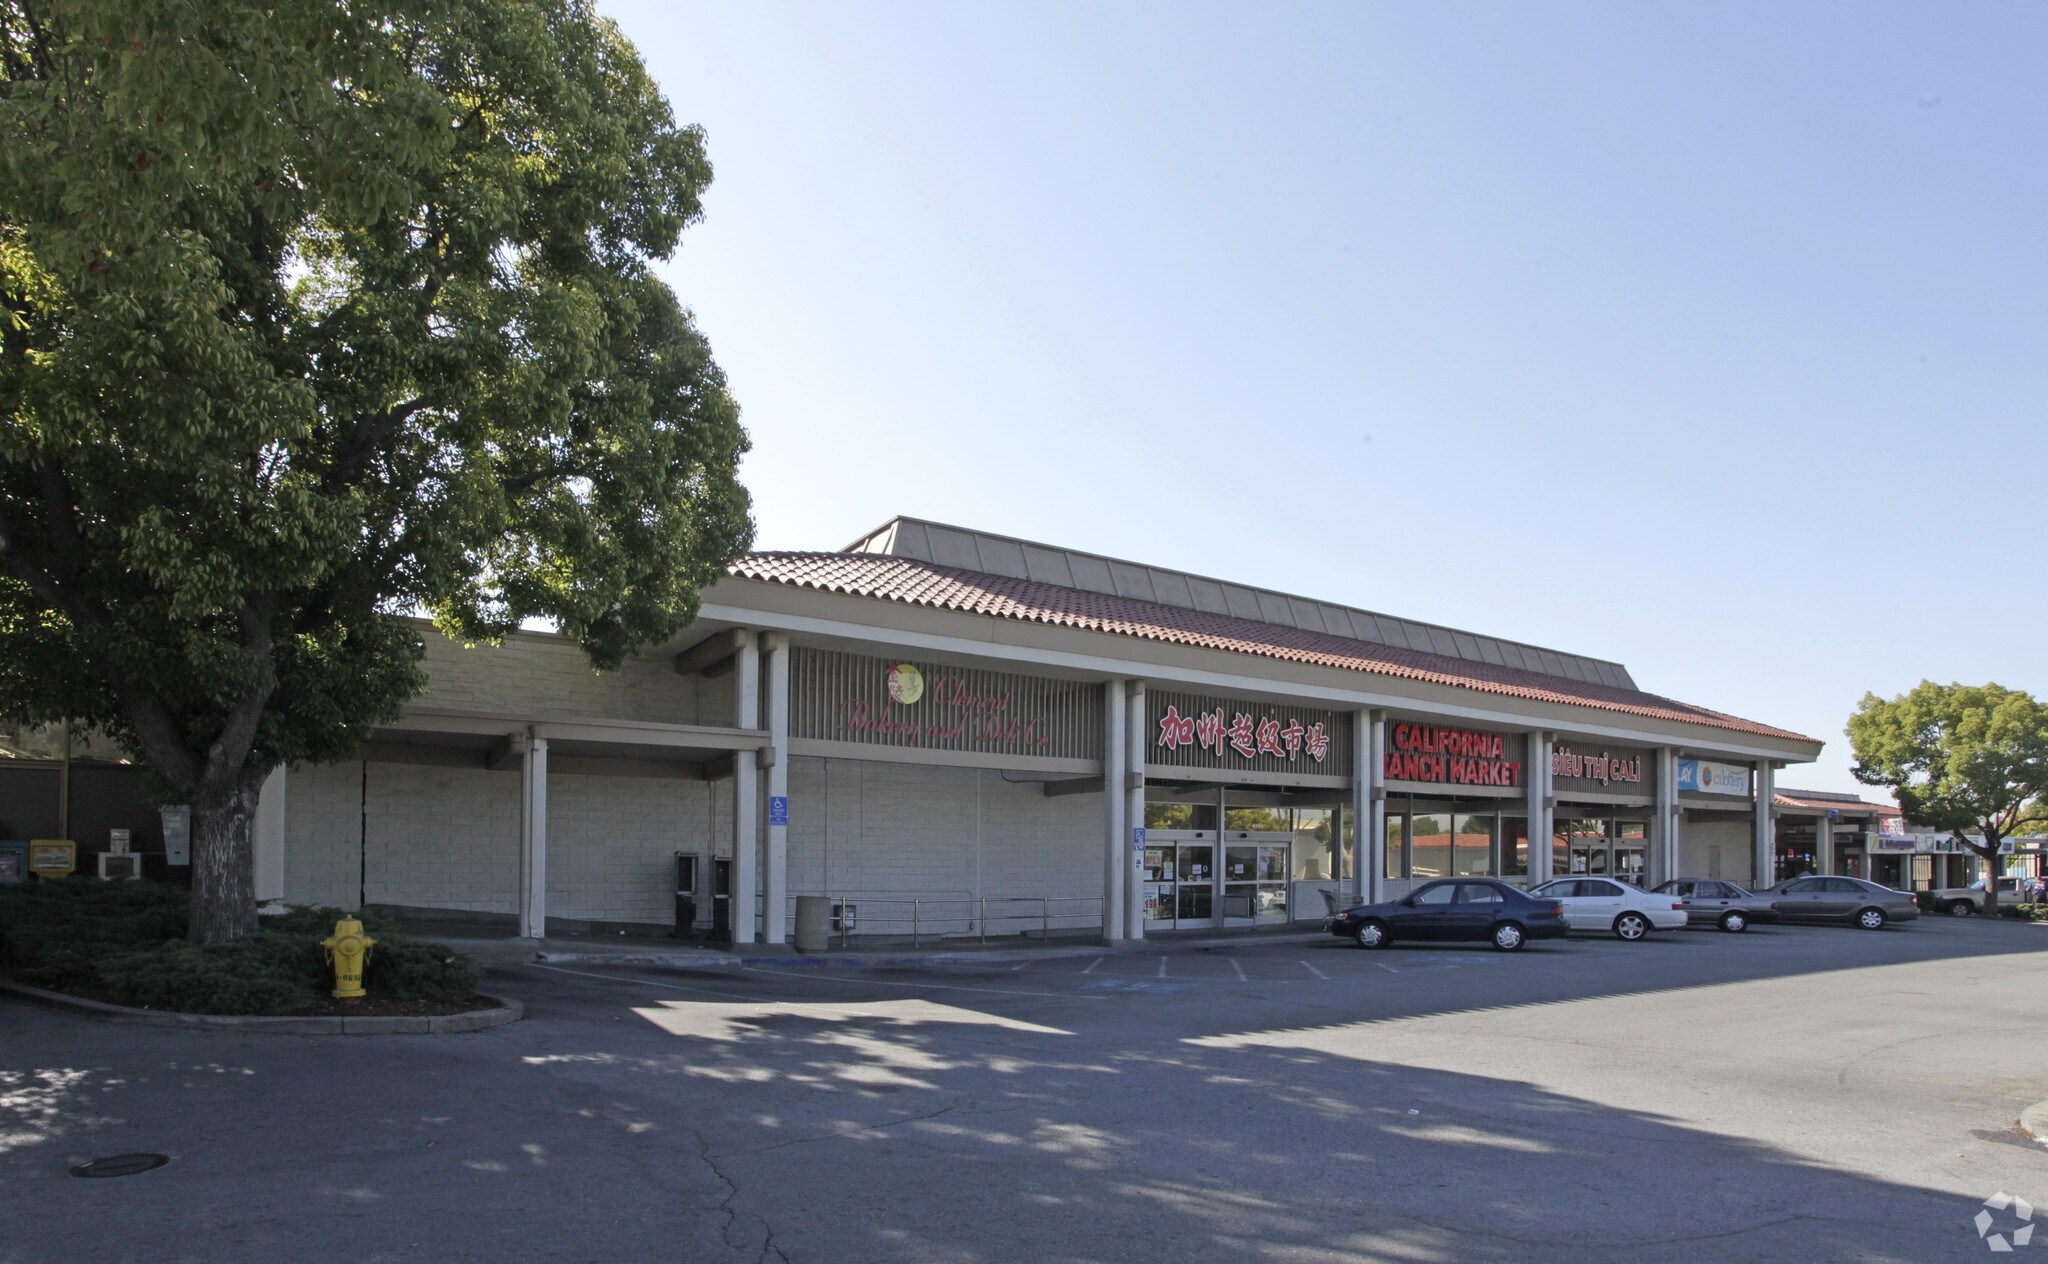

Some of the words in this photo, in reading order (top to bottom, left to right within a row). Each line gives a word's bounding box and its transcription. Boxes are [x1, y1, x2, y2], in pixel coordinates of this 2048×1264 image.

[934, 672, 1011, 711] Clement
[838, 698, 920, 748] Bakery
[926, 712, 969, 740] and
[972, 712, 1020, 744] Deli
[1395, 723, 1505, 759] CALIFORNIA
[1450, 758, 1520, 787] MARKET
